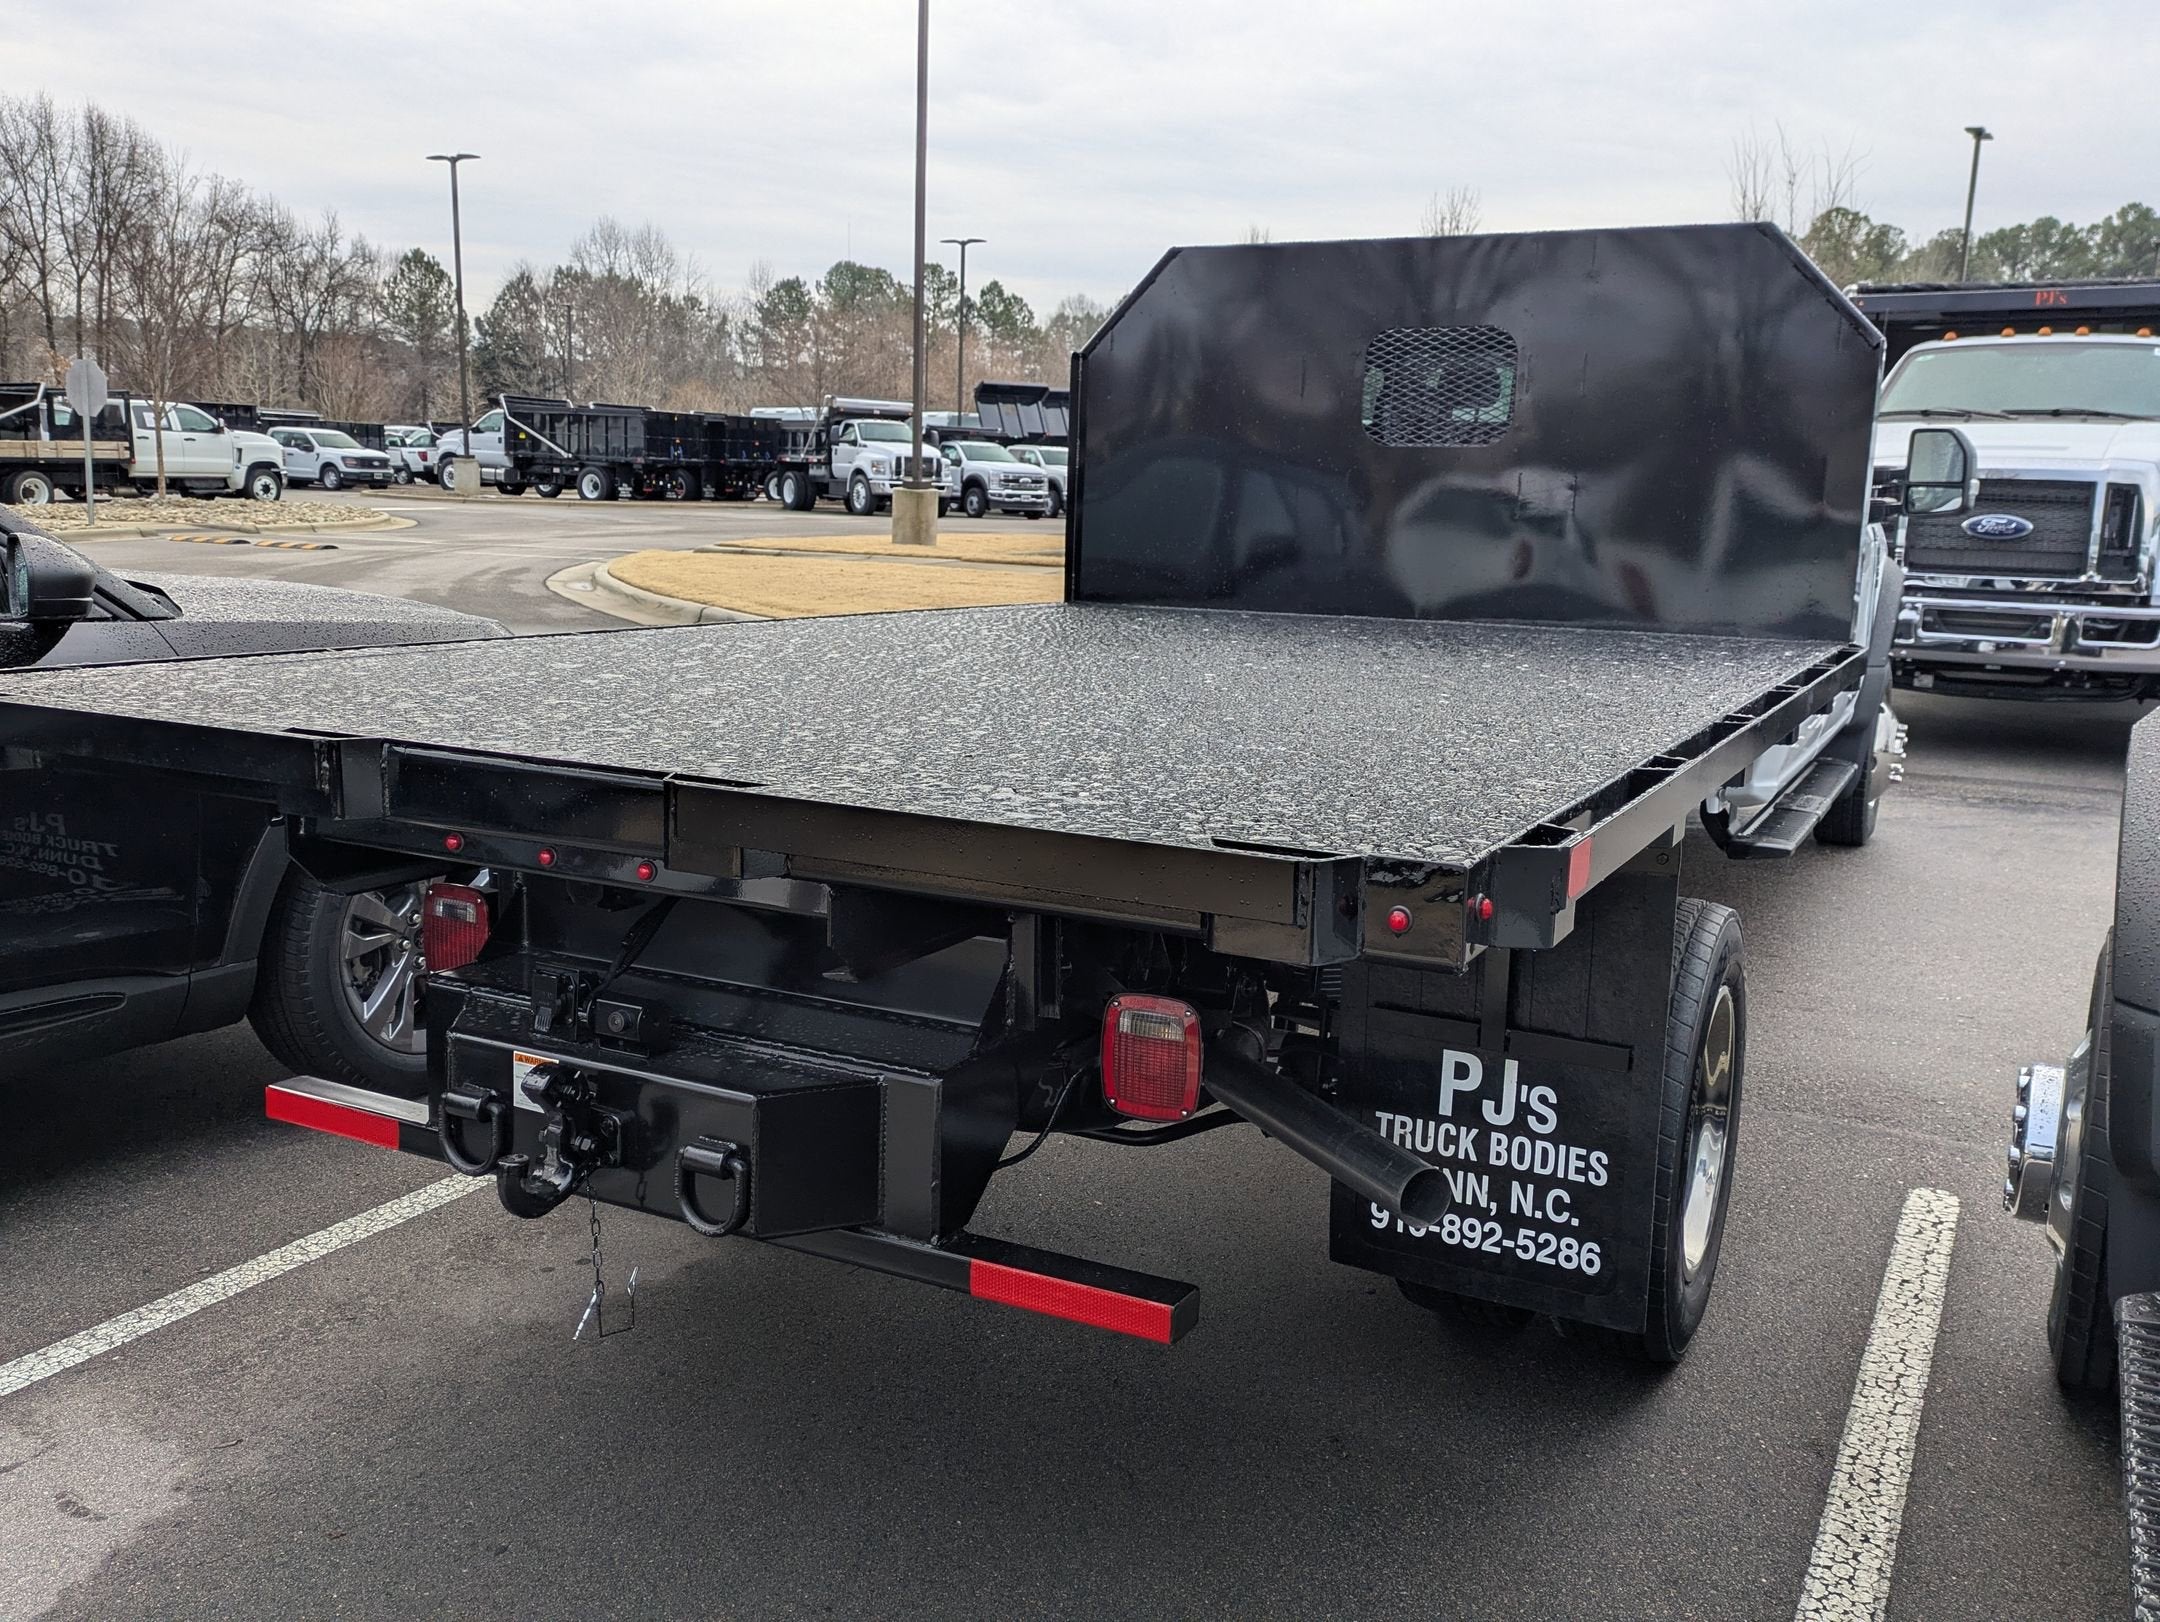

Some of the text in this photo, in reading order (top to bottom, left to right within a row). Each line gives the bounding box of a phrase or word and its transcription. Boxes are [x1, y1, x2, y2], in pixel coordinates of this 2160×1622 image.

[1976, 517, 2017, 535] Ford
[1375, 1111, 1609, 1187] TRUCK BODIES
[1441, 1166, 1579, 1226] NN, N.C.
